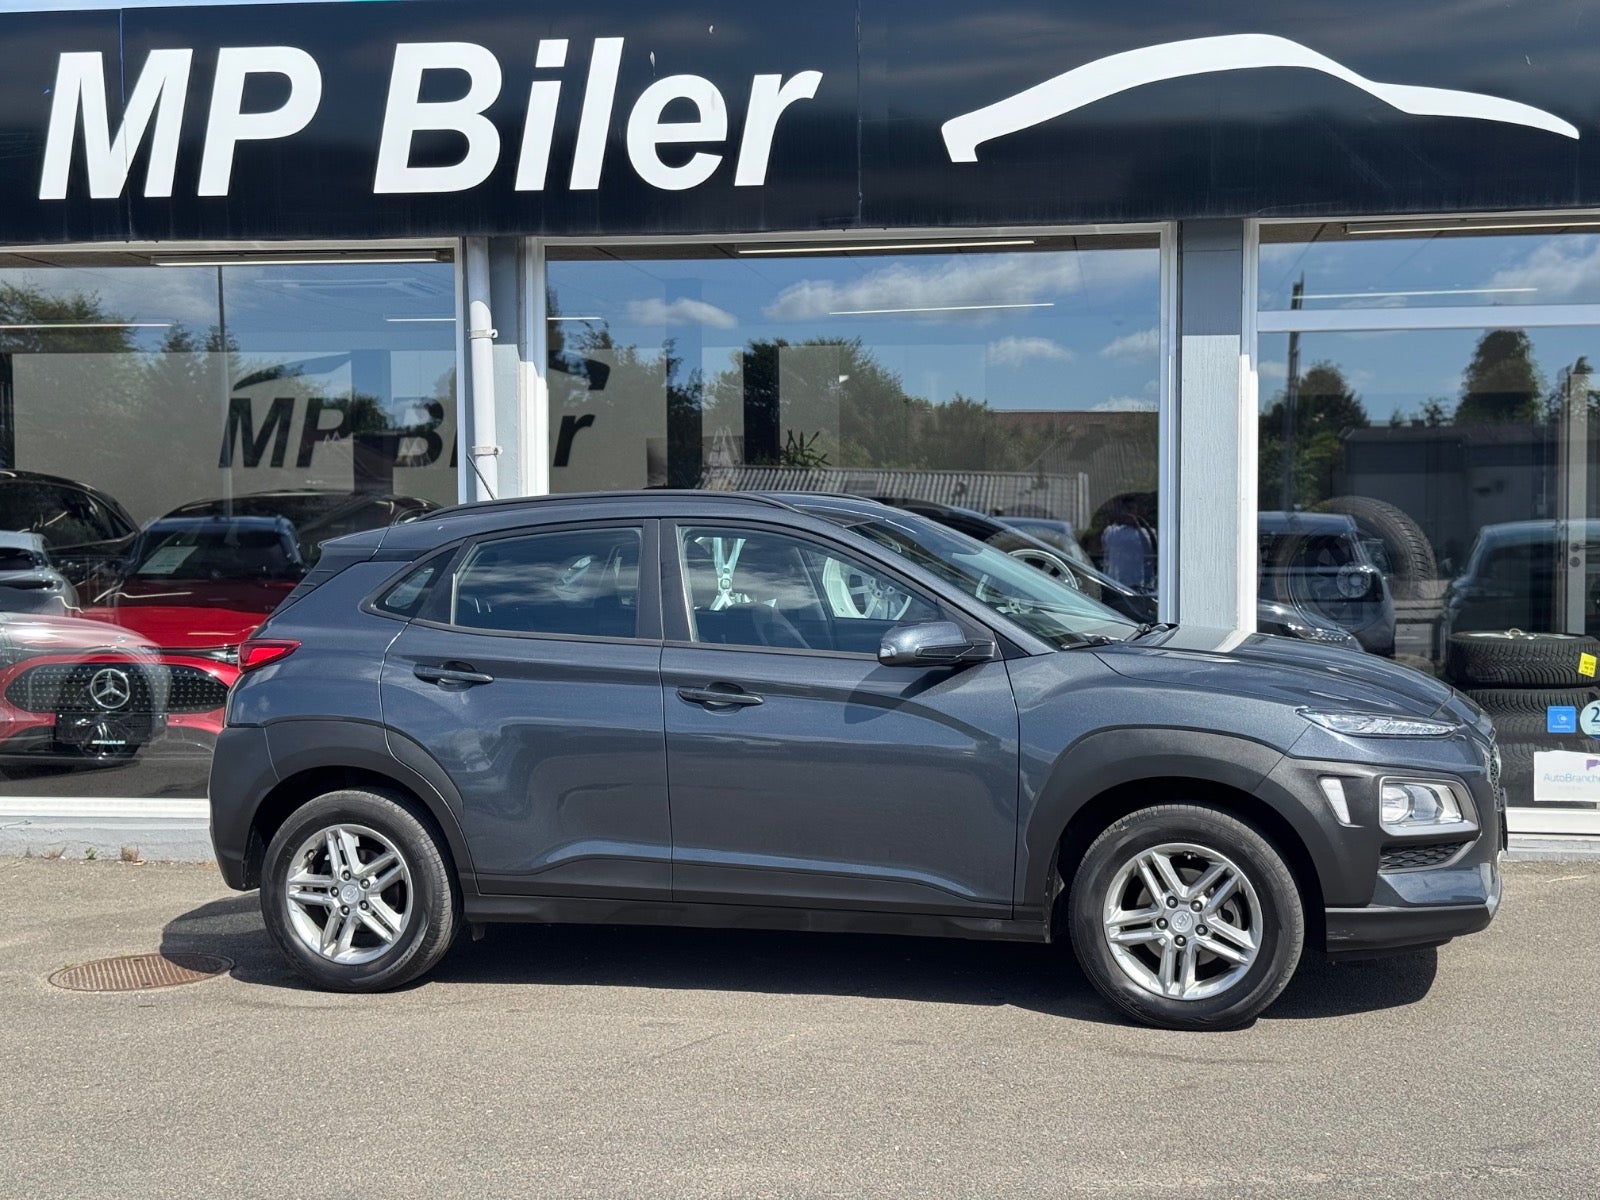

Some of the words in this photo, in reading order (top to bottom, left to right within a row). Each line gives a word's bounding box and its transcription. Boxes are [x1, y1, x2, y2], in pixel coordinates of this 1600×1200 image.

[39, 46, 323, 200] MP
[373, 36, 823, 194] Biler
[218, 397, 354, 469] MP
